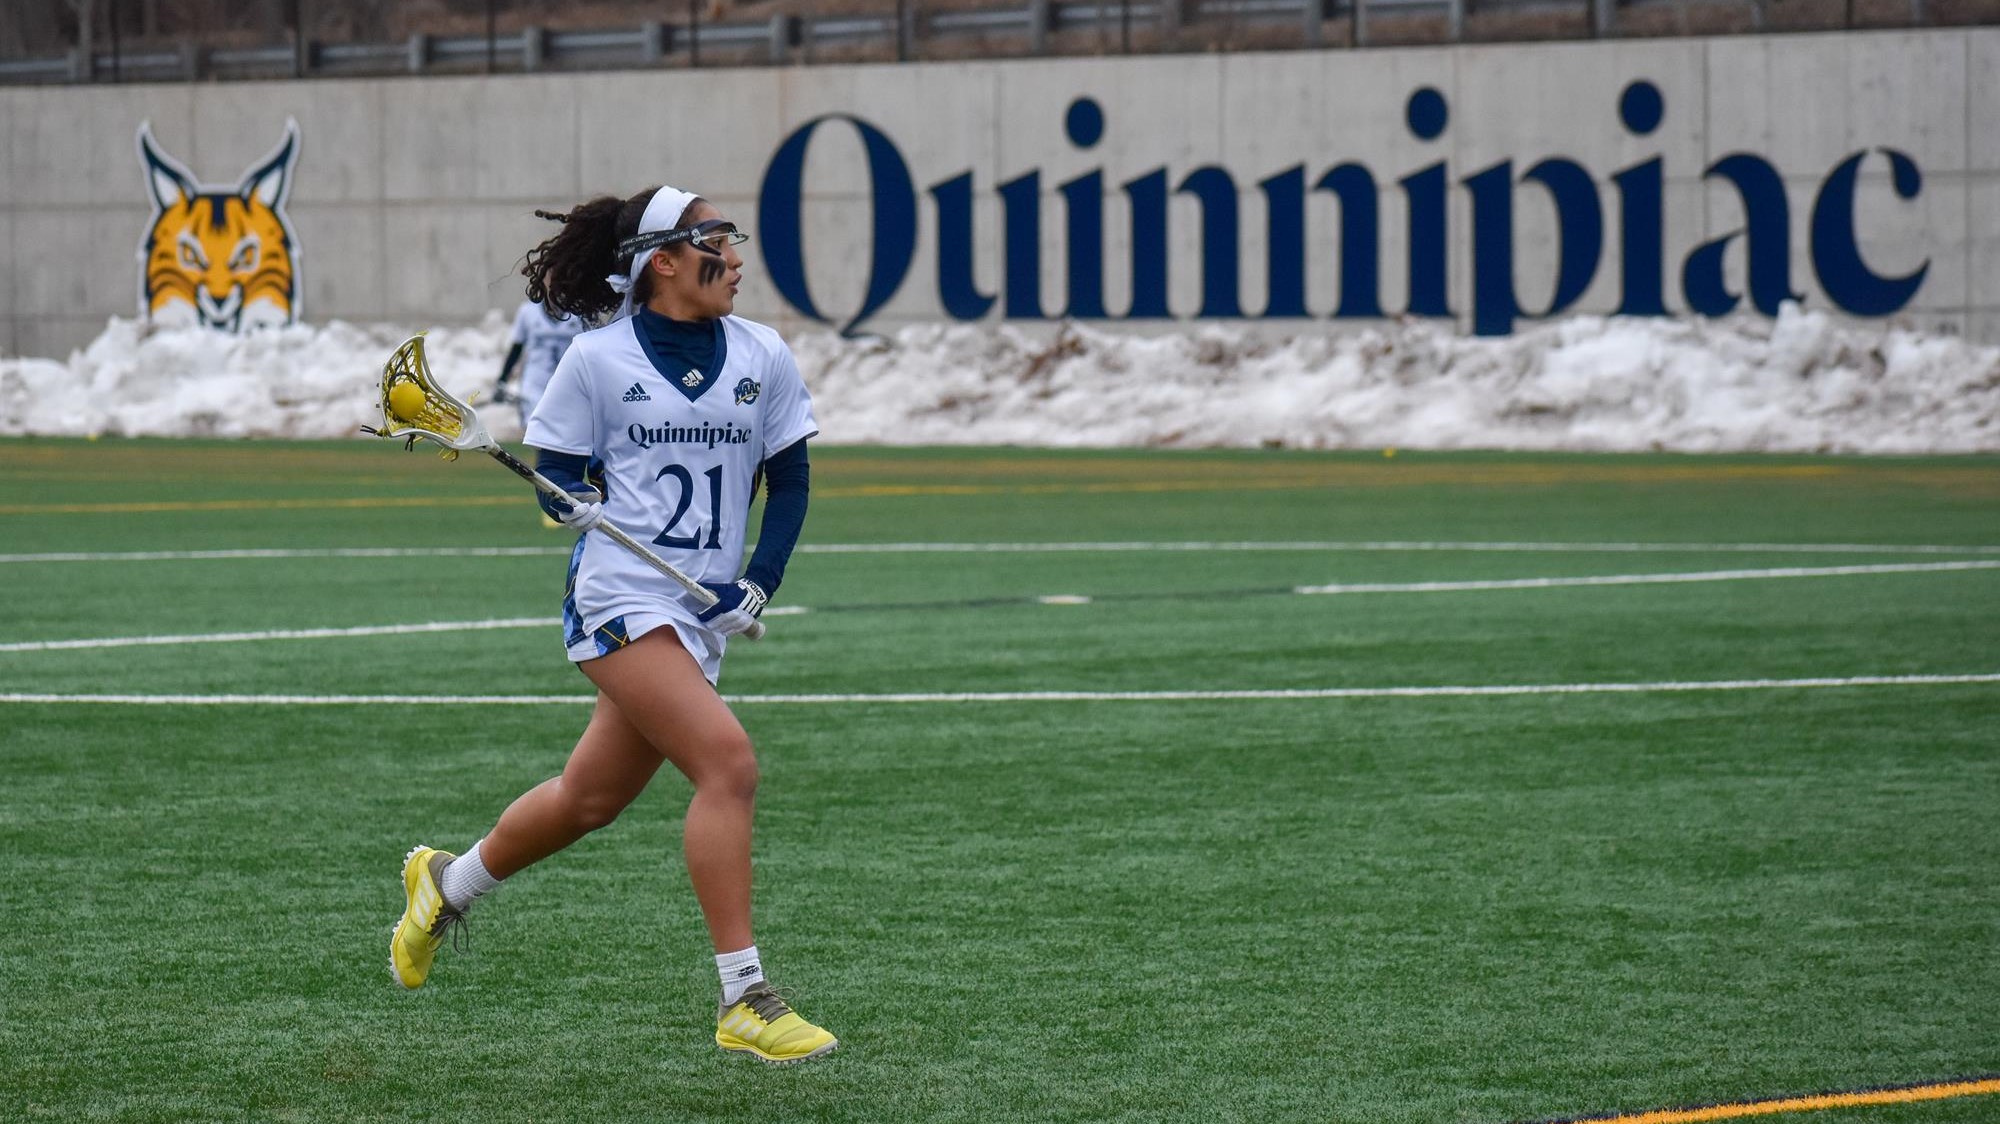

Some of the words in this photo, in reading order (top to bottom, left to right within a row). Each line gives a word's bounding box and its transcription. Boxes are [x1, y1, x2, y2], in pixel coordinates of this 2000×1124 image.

[758, 79, 1930, 338] Quinnipiac
[622, 393, 652, 403] adidas
[733, 381, 761, 404] MAAC
[627, 421, 752, 449] Quinnipiac
[652, 463, 723, 549] 21
[738, 966, 759, 977] adidas
